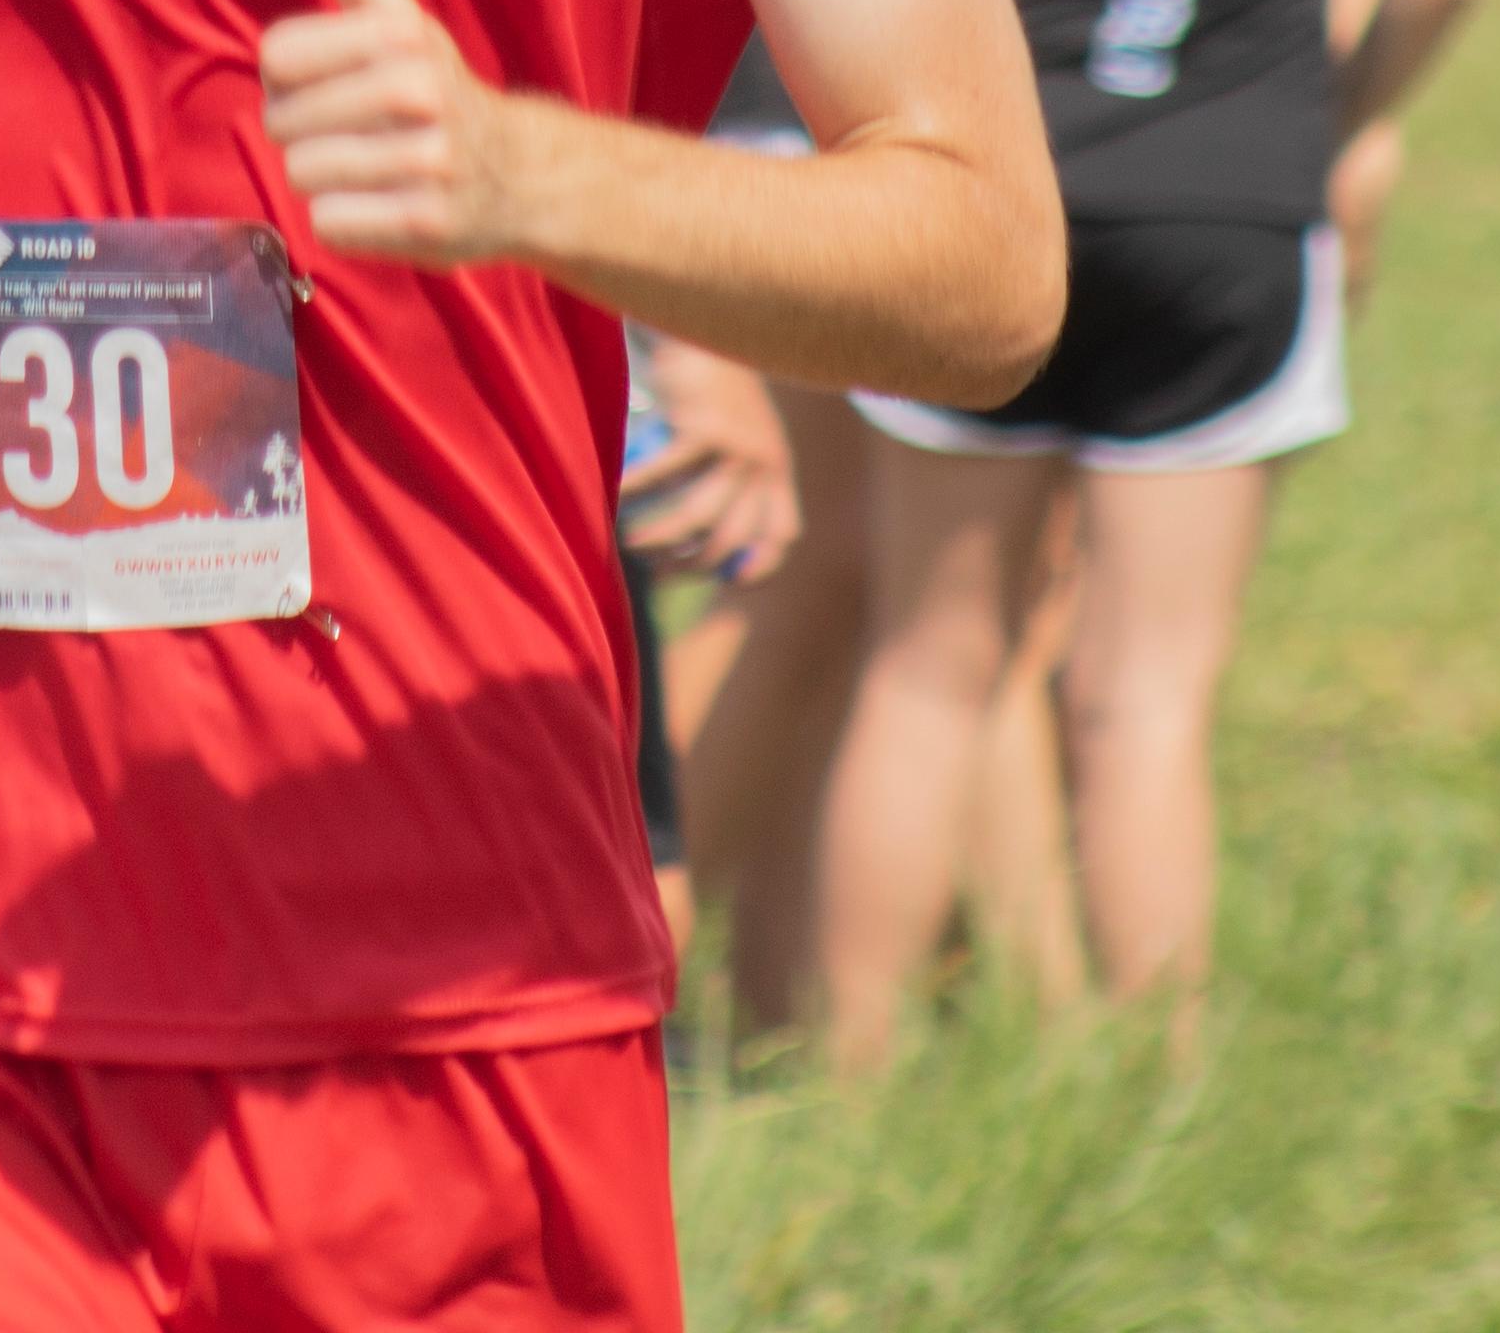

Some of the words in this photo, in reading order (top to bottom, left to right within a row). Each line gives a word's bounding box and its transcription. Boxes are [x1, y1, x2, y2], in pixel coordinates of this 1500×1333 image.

[21, 236, 73, 260] ROAD
[70, 279, 87, 301] get
[89, 282, 106, 298] run
[109, 282, 131, 298] over
[134, 278, 142, 298] if
[144, 281, 163, 301] you
[164, 279, 186, 300] just
[48, 297, 86, 320] Rogers
